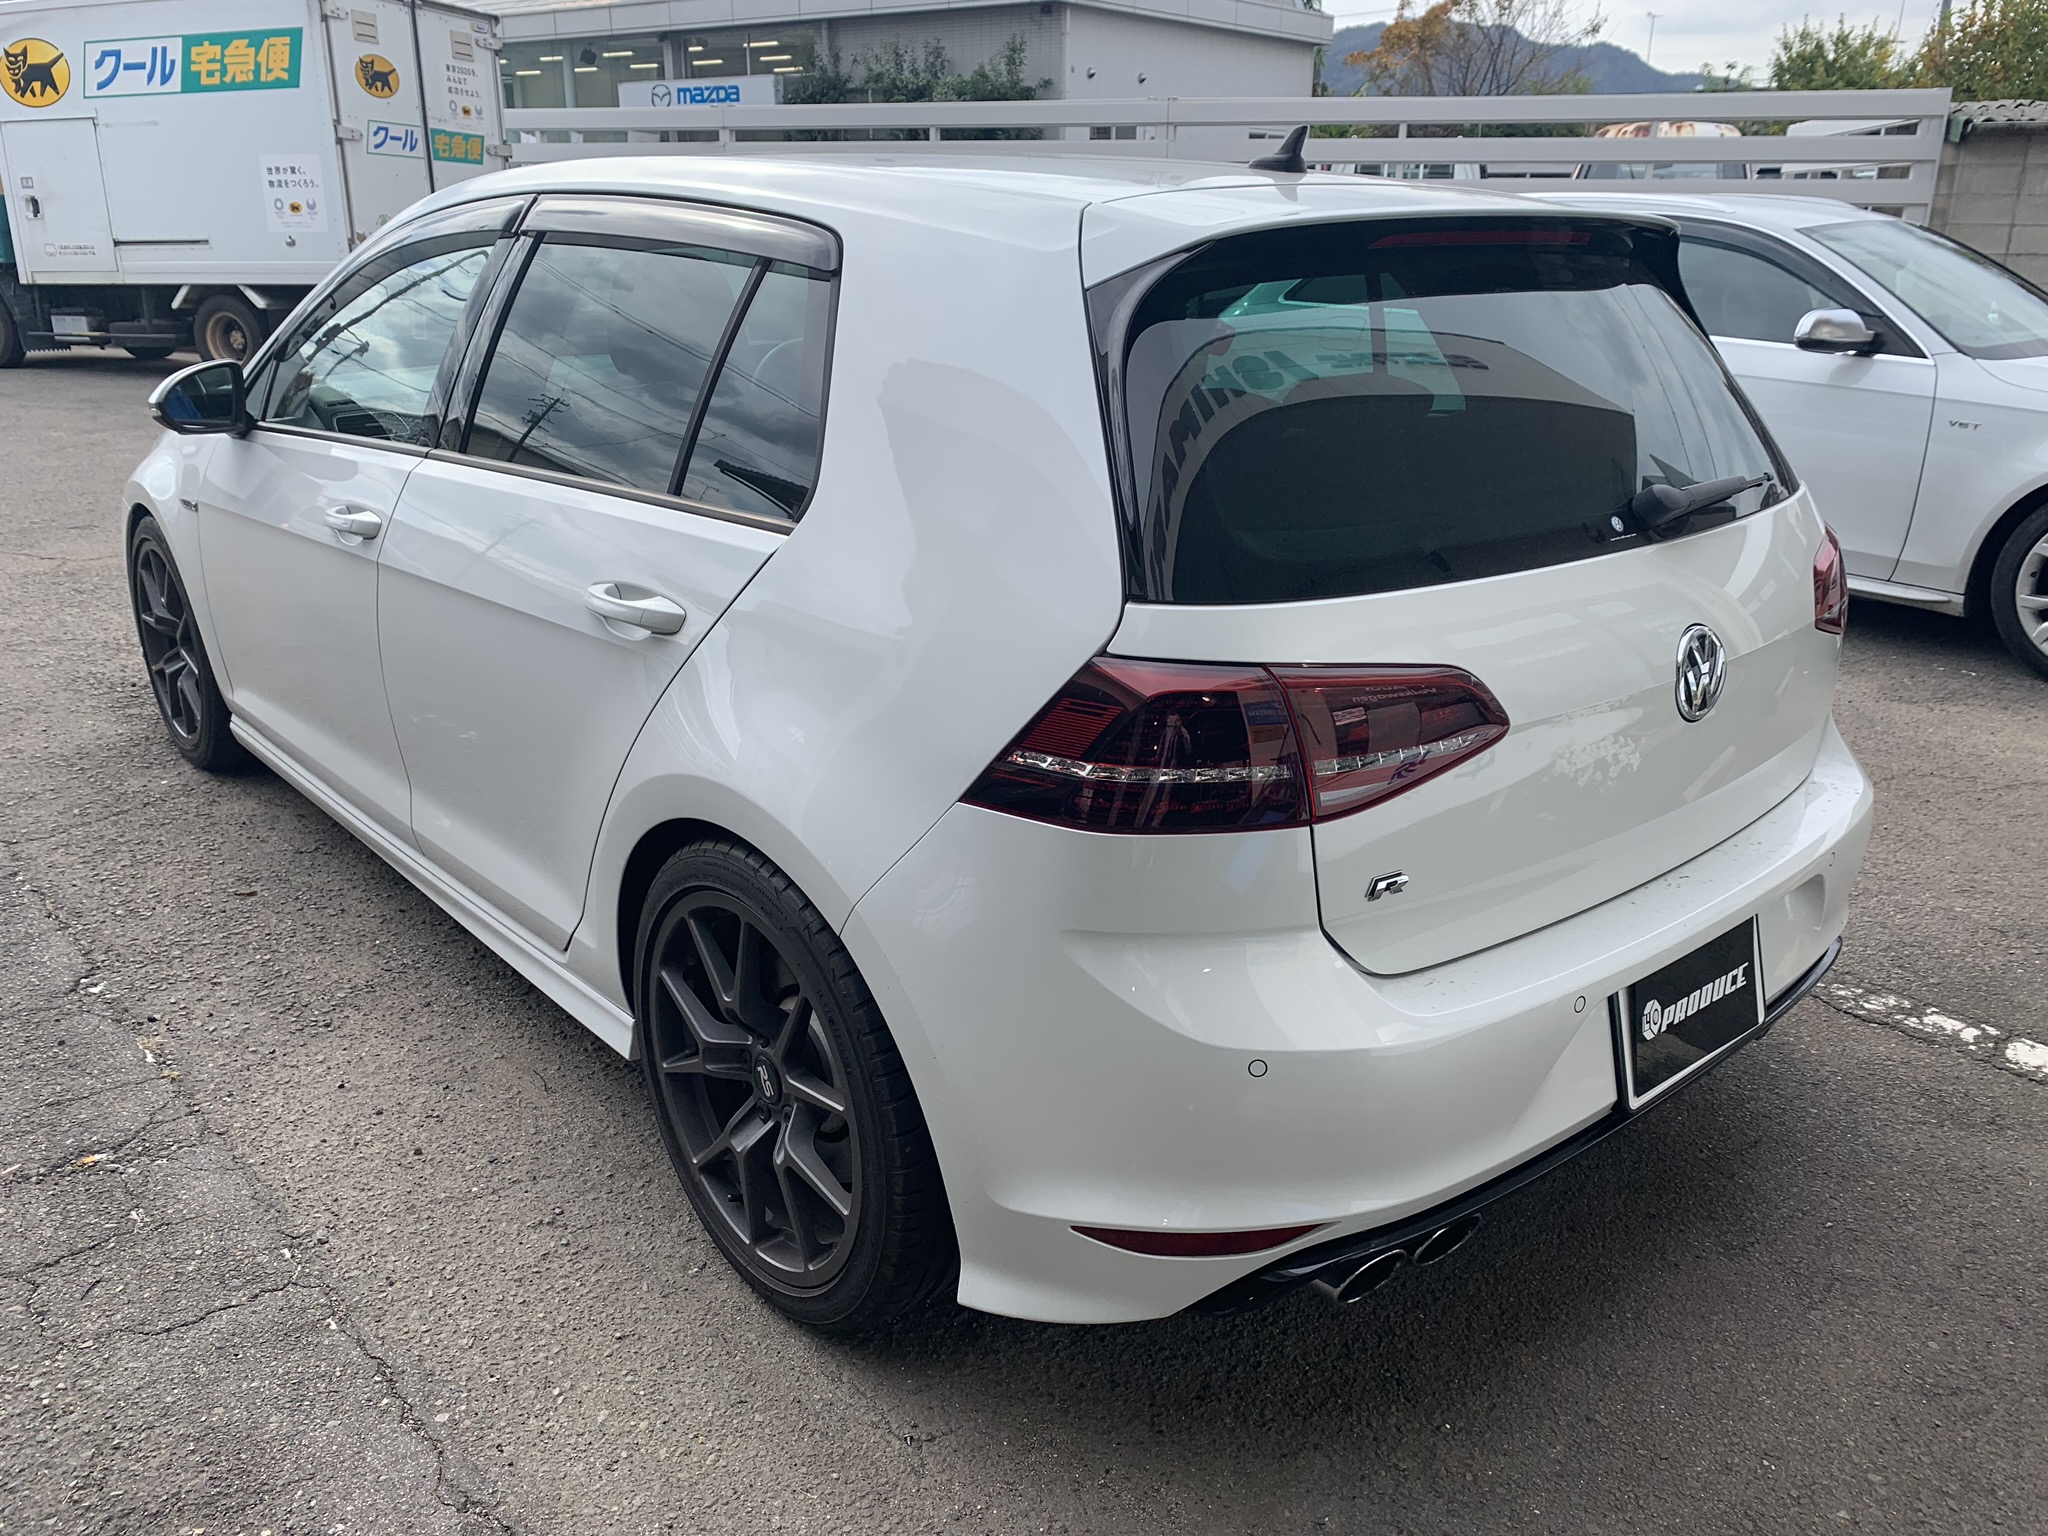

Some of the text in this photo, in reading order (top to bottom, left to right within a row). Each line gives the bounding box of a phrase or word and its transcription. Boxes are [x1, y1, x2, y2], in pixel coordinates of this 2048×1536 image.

[95, 36, 291, 91] クール 宅急便
[373, 125, 482, 160] クール 宅急便
[266, 166, 306, 175] 世界が驚く、
[268, 179, 319, 188] 物流をつくろう。
[1365, 869, 1409, 902] R
[1660, 962, 1749, 1033] PRODUCE
[757, 1065, 774, 1097] RS
